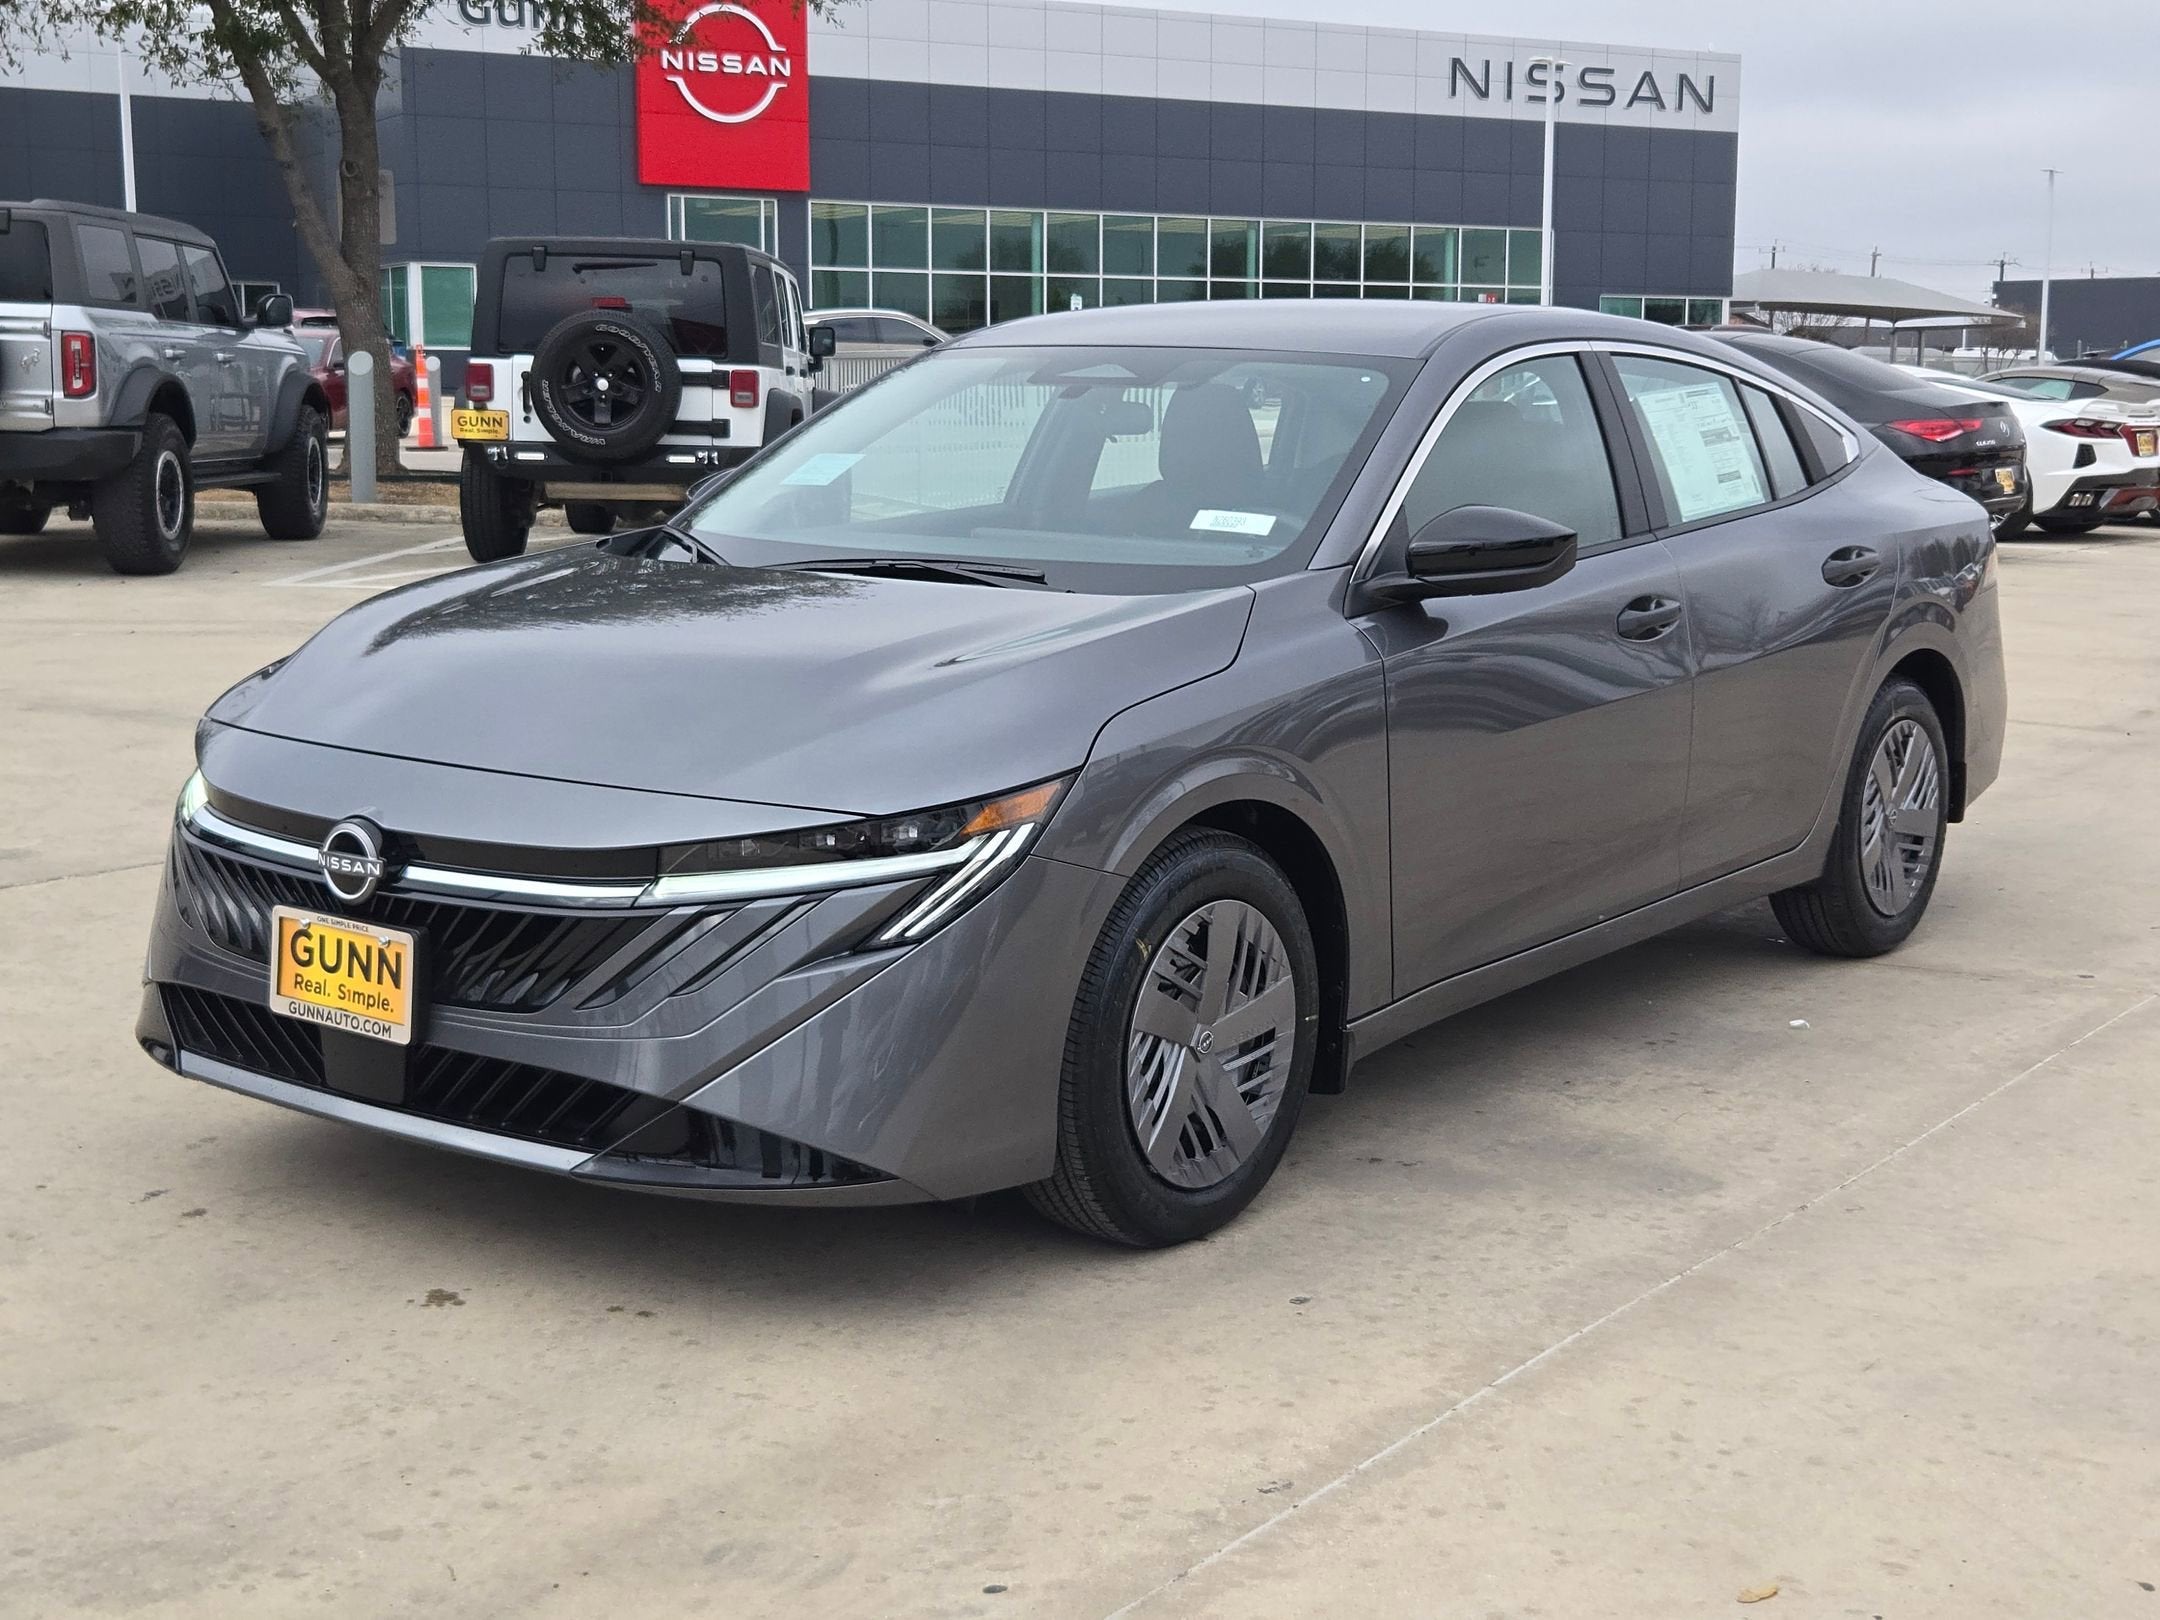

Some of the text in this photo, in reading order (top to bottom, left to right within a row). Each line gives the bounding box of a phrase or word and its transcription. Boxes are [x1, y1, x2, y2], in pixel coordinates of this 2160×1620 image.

[661, 49, 791, 77] NISSAN
[1450, 57, 1714, 114] NISSAN
[457, 415, 503, 428] GUNN
[318, 852, 380, 875] NISSAN
[290, 929, 402, 990] GUNN
[294, 973, 331, 997] Real.
[288, 1001, 392, 1039] GUNNAUTO.COM
